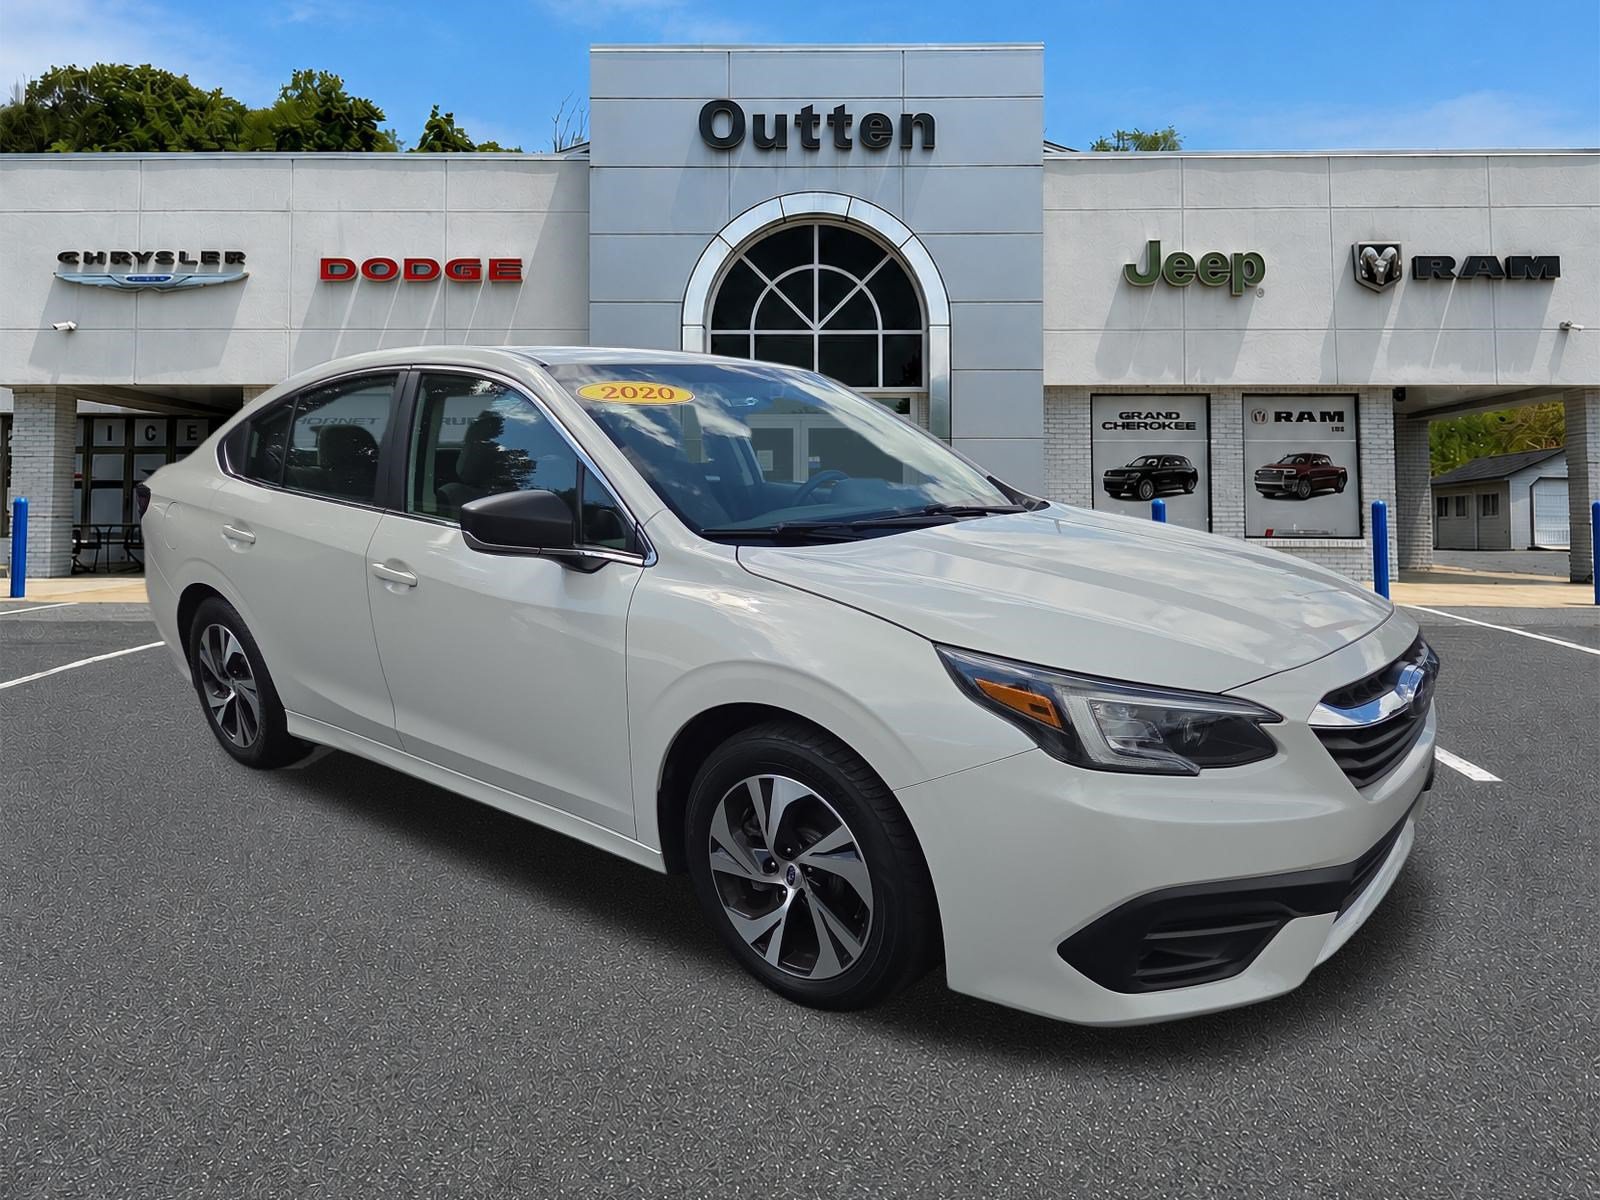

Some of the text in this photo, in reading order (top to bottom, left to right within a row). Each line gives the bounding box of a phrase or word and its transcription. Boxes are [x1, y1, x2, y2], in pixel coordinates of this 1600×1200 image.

[698, 99, 936, 150] Outten
[56, 250, 247, 265] CHRYSLER
[320, 257, 523, 282] DODGE
[1123, 240, 1266, 296] Jeep
[1411, 255, 1561, 280] RAM
[600, 386, 675, 400] 2020
[1118, 411, 1181, 420] GRAND
[1274, 411, 1345, 422] RAM
[1101, 421, 1197, 431] CHEROKEE
